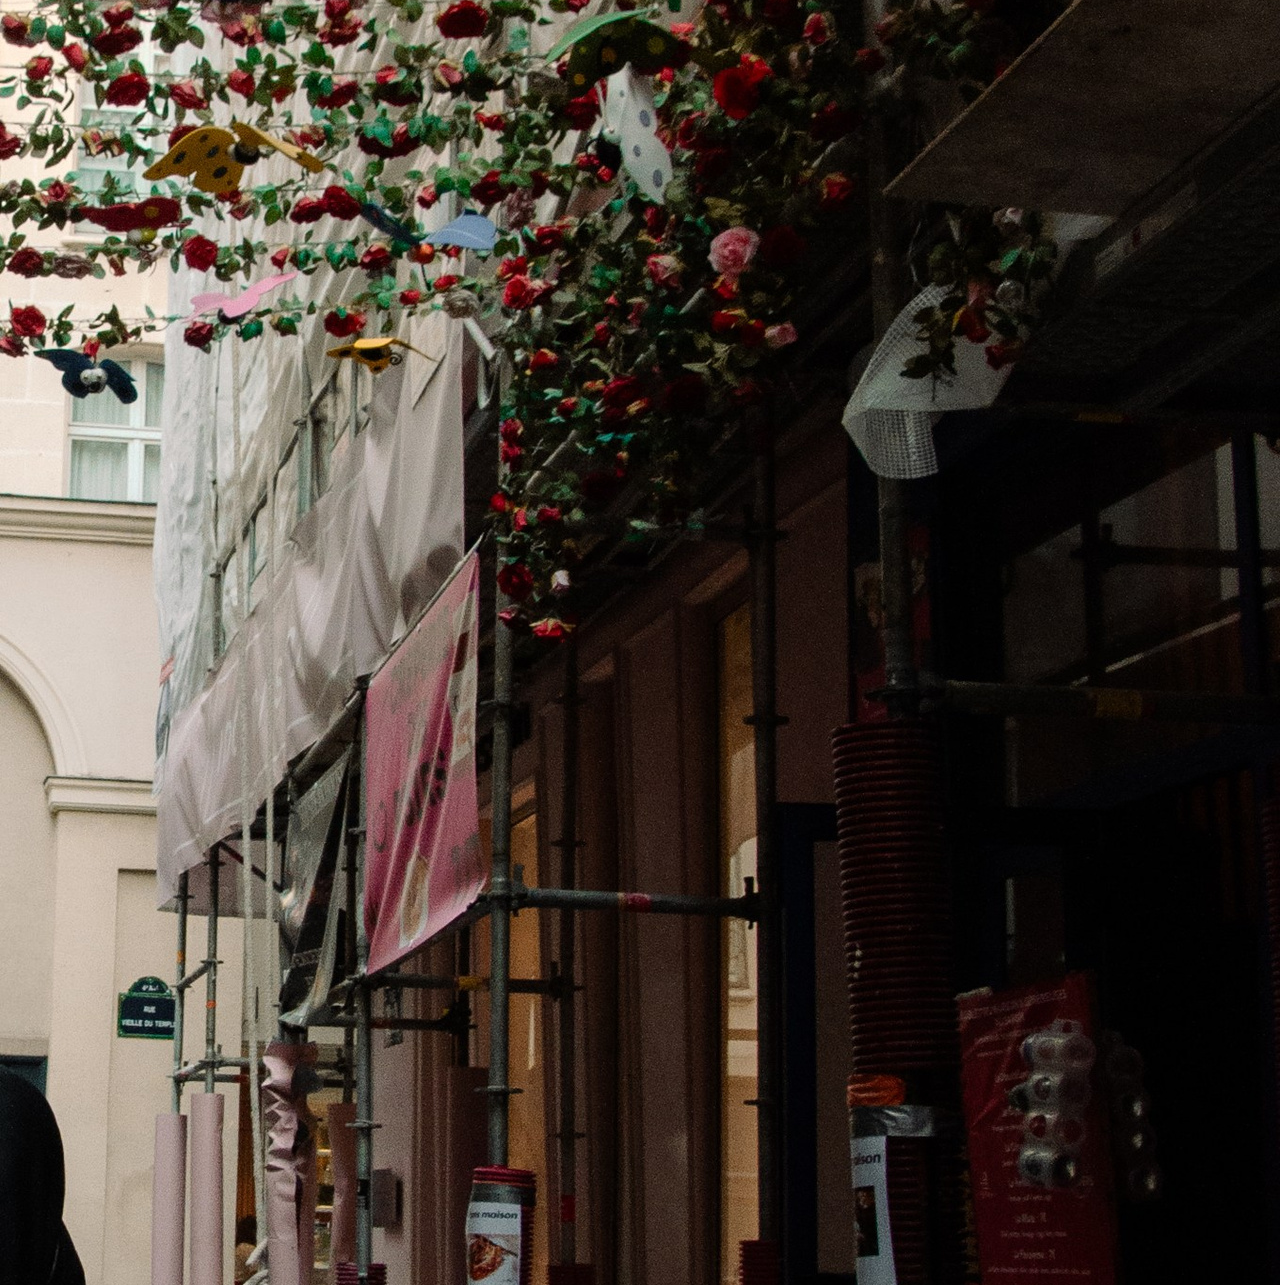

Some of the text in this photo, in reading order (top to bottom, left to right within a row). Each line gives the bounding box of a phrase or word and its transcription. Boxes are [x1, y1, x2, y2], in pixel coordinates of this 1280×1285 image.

[143, 1005, 156, 1014] RUE
[144, 1019, 153, 1027] DU
[155, 1020, 175, 1028] TEMPL
[482, 1210, 518, 1220] maison
